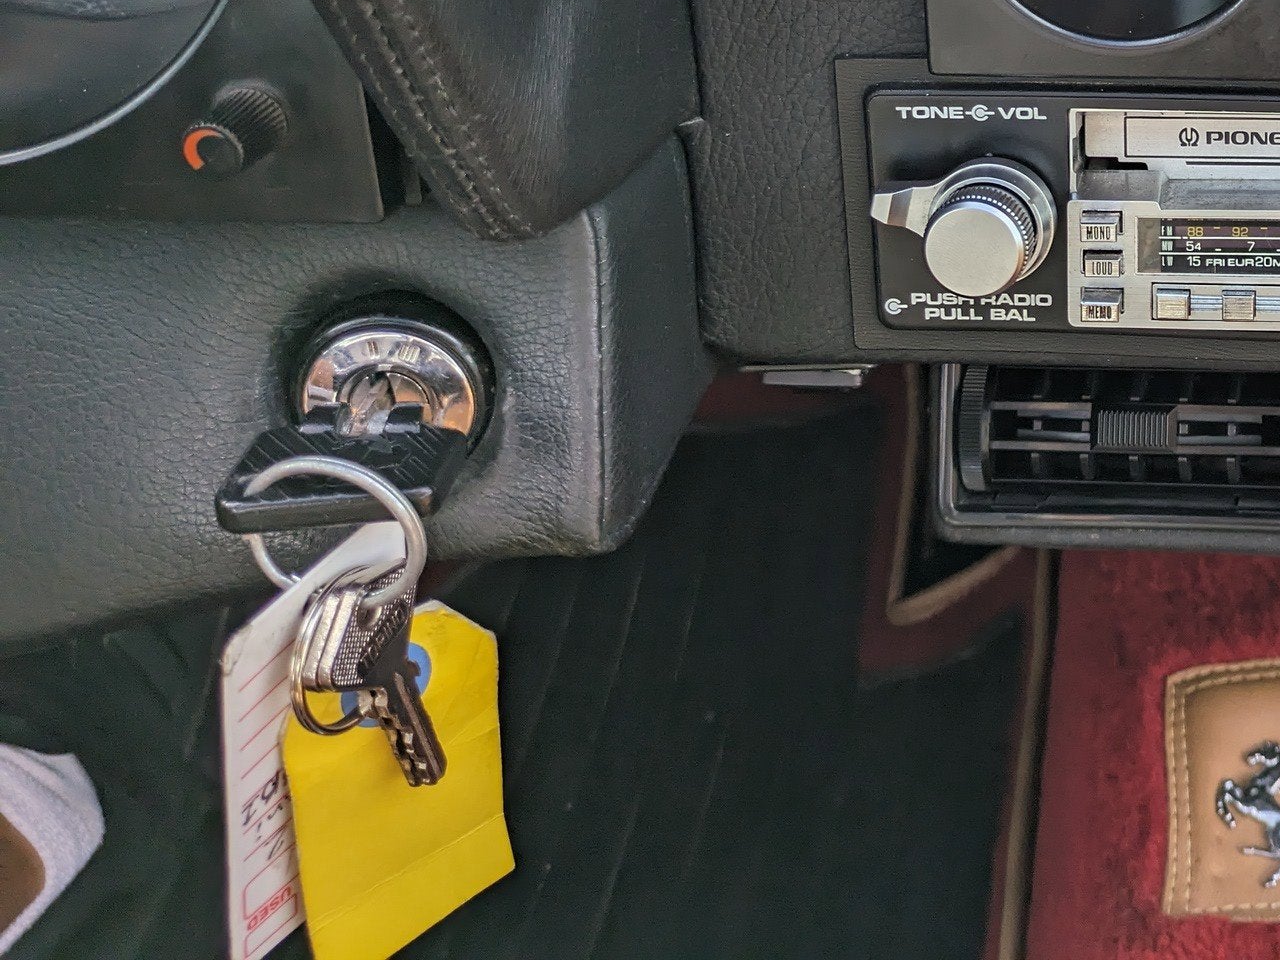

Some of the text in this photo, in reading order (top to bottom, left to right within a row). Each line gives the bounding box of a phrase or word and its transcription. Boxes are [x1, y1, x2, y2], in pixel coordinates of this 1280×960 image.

[895, 106, 1048, 120] TONE VOL
[1086, 226, 1111, 240] MONO
[1187, 227, 1204, 237] 88
[1232, 227, 1248, 237] 92
[1186, 241, 1201, 251] 54
[1247, 241, 1256, 252] 7
[1092, 261, 1112, 275] LOUD
[1187, 256, 1201, 267] 15
[1255, 256, 1271, 267] 20
[910, 292, 1053, 307] PUSH RADIO
[924, 308, 1036, 322] PULL BAL
[247, 886, 292, 932] USED
